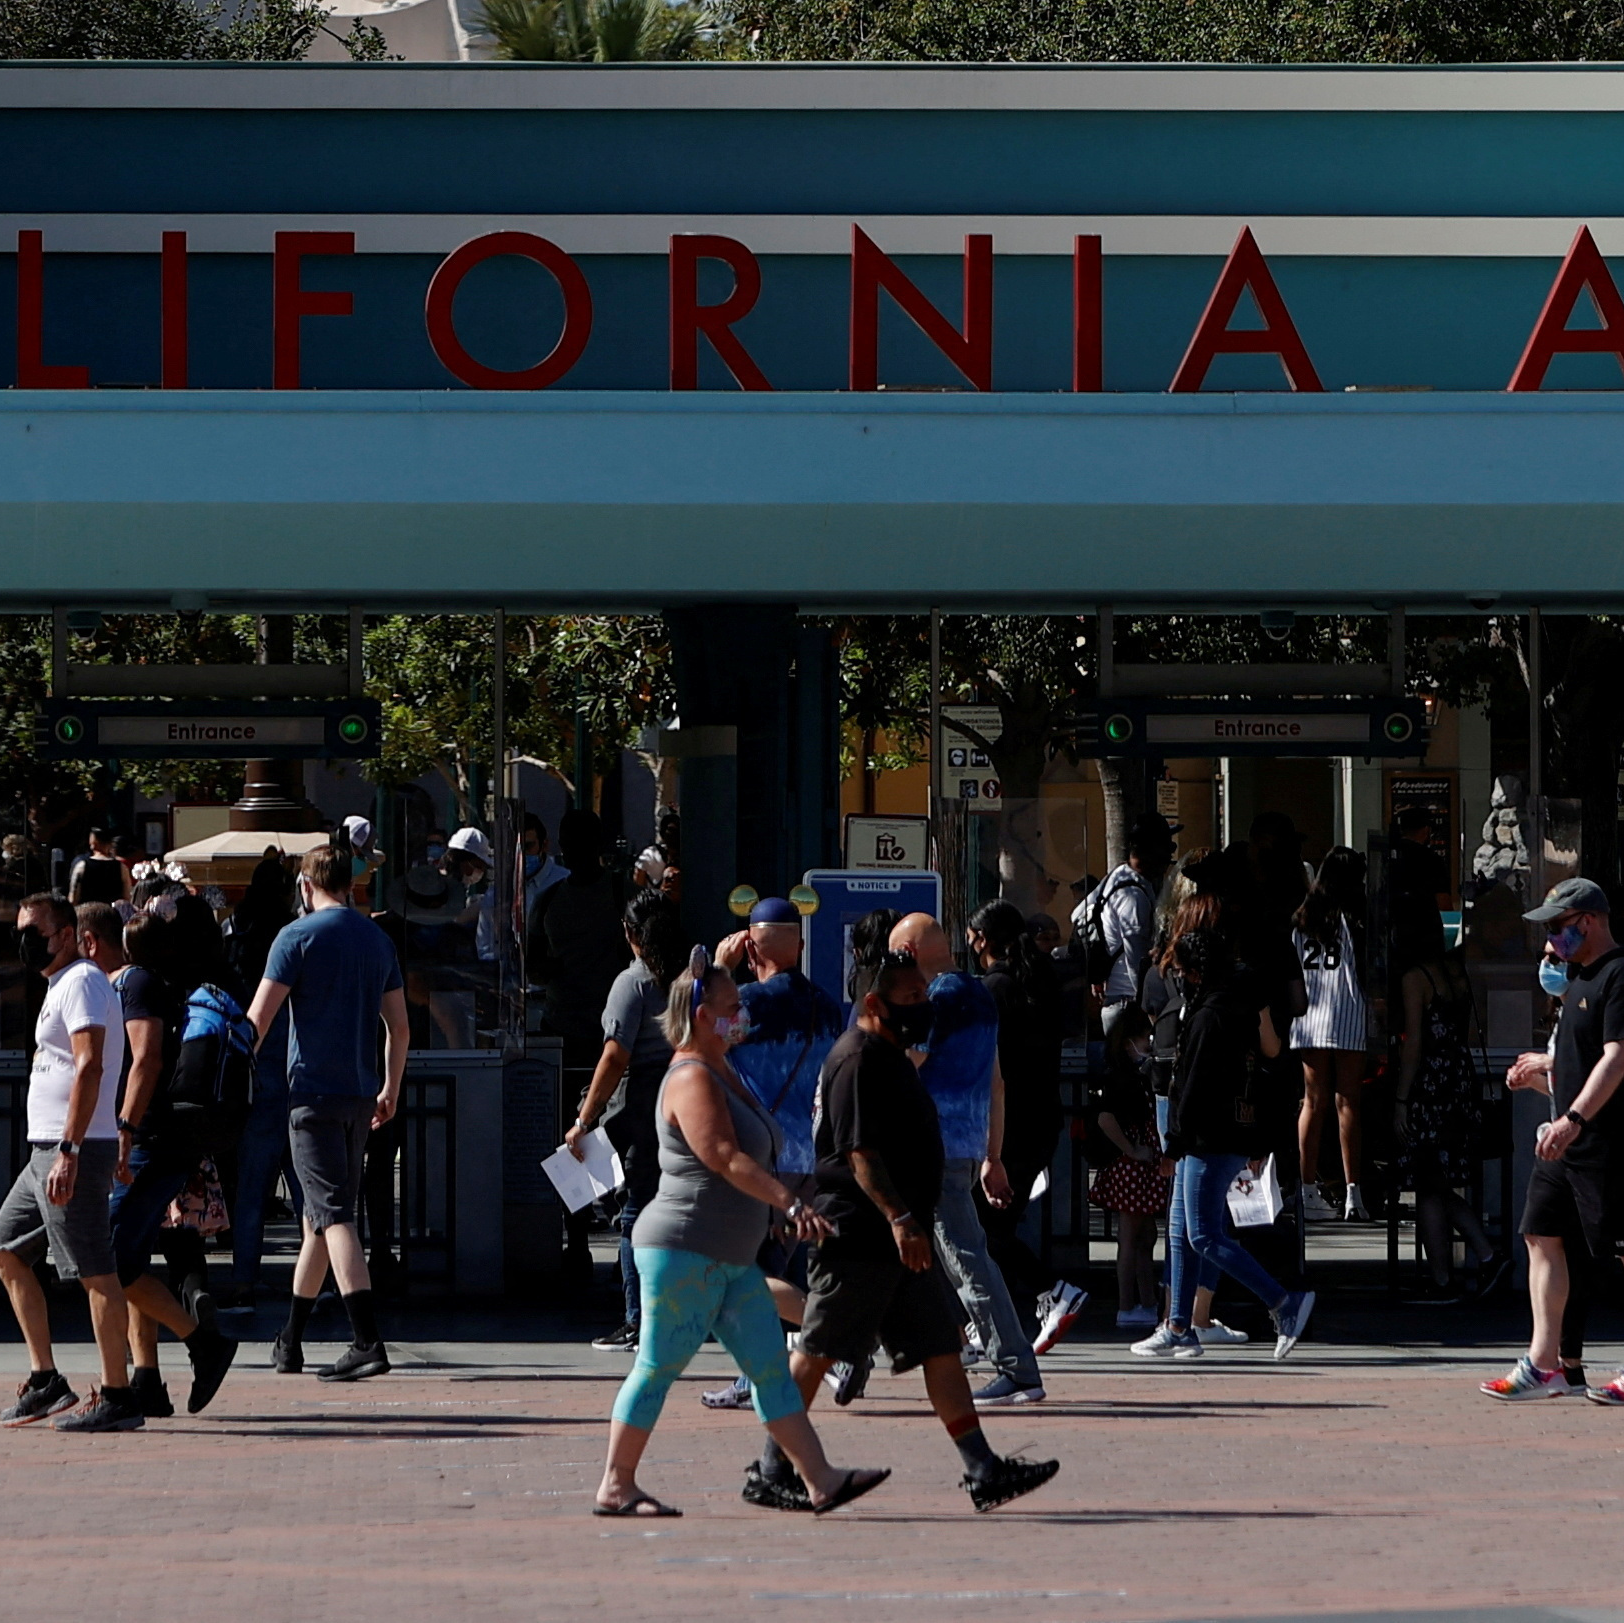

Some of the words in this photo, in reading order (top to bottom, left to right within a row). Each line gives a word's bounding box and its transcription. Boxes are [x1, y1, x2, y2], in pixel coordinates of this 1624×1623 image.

[167, 723, 256, 739] Entrance
[1214, 720, 1301, 736] Entrance
[1303, 938, 1341, 970] 28
